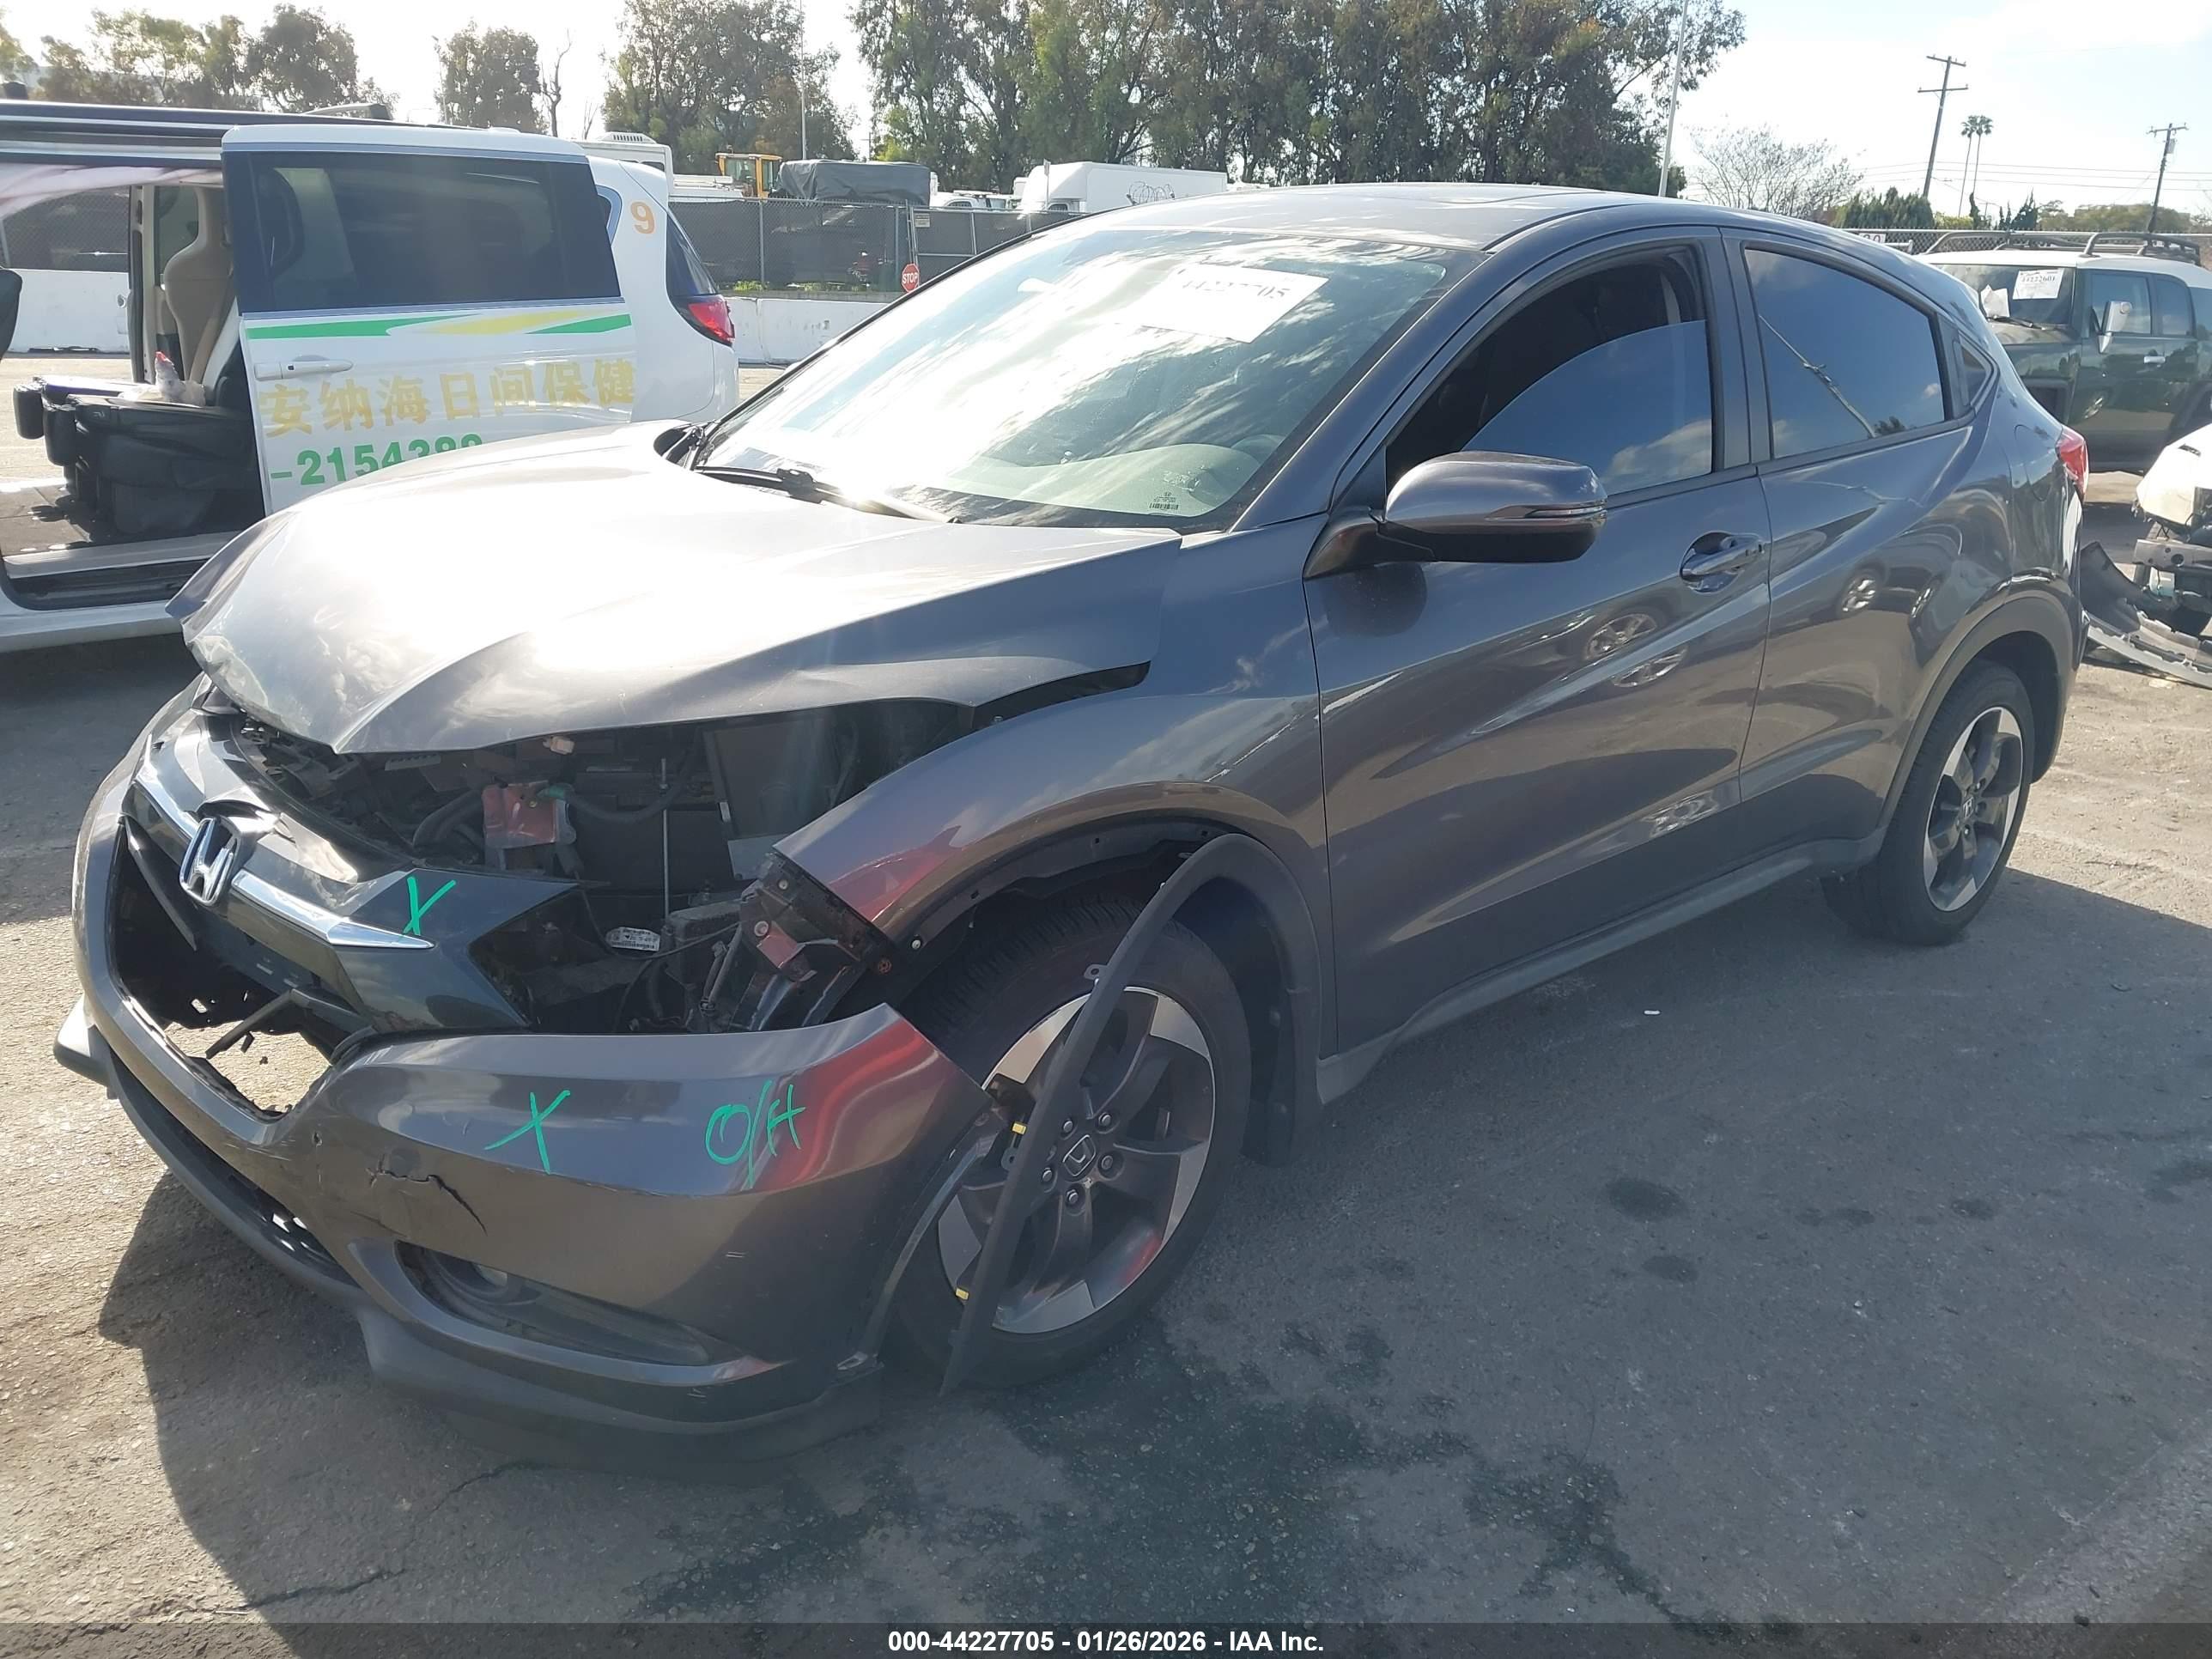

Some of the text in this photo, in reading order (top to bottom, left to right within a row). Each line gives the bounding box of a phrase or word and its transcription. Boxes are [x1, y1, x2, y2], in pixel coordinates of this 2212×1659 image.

[630, 201, 655, 234] 9
[902, 272, 919, 284] STOP
[260, 358, 635, 438] 安纳海日间保健
